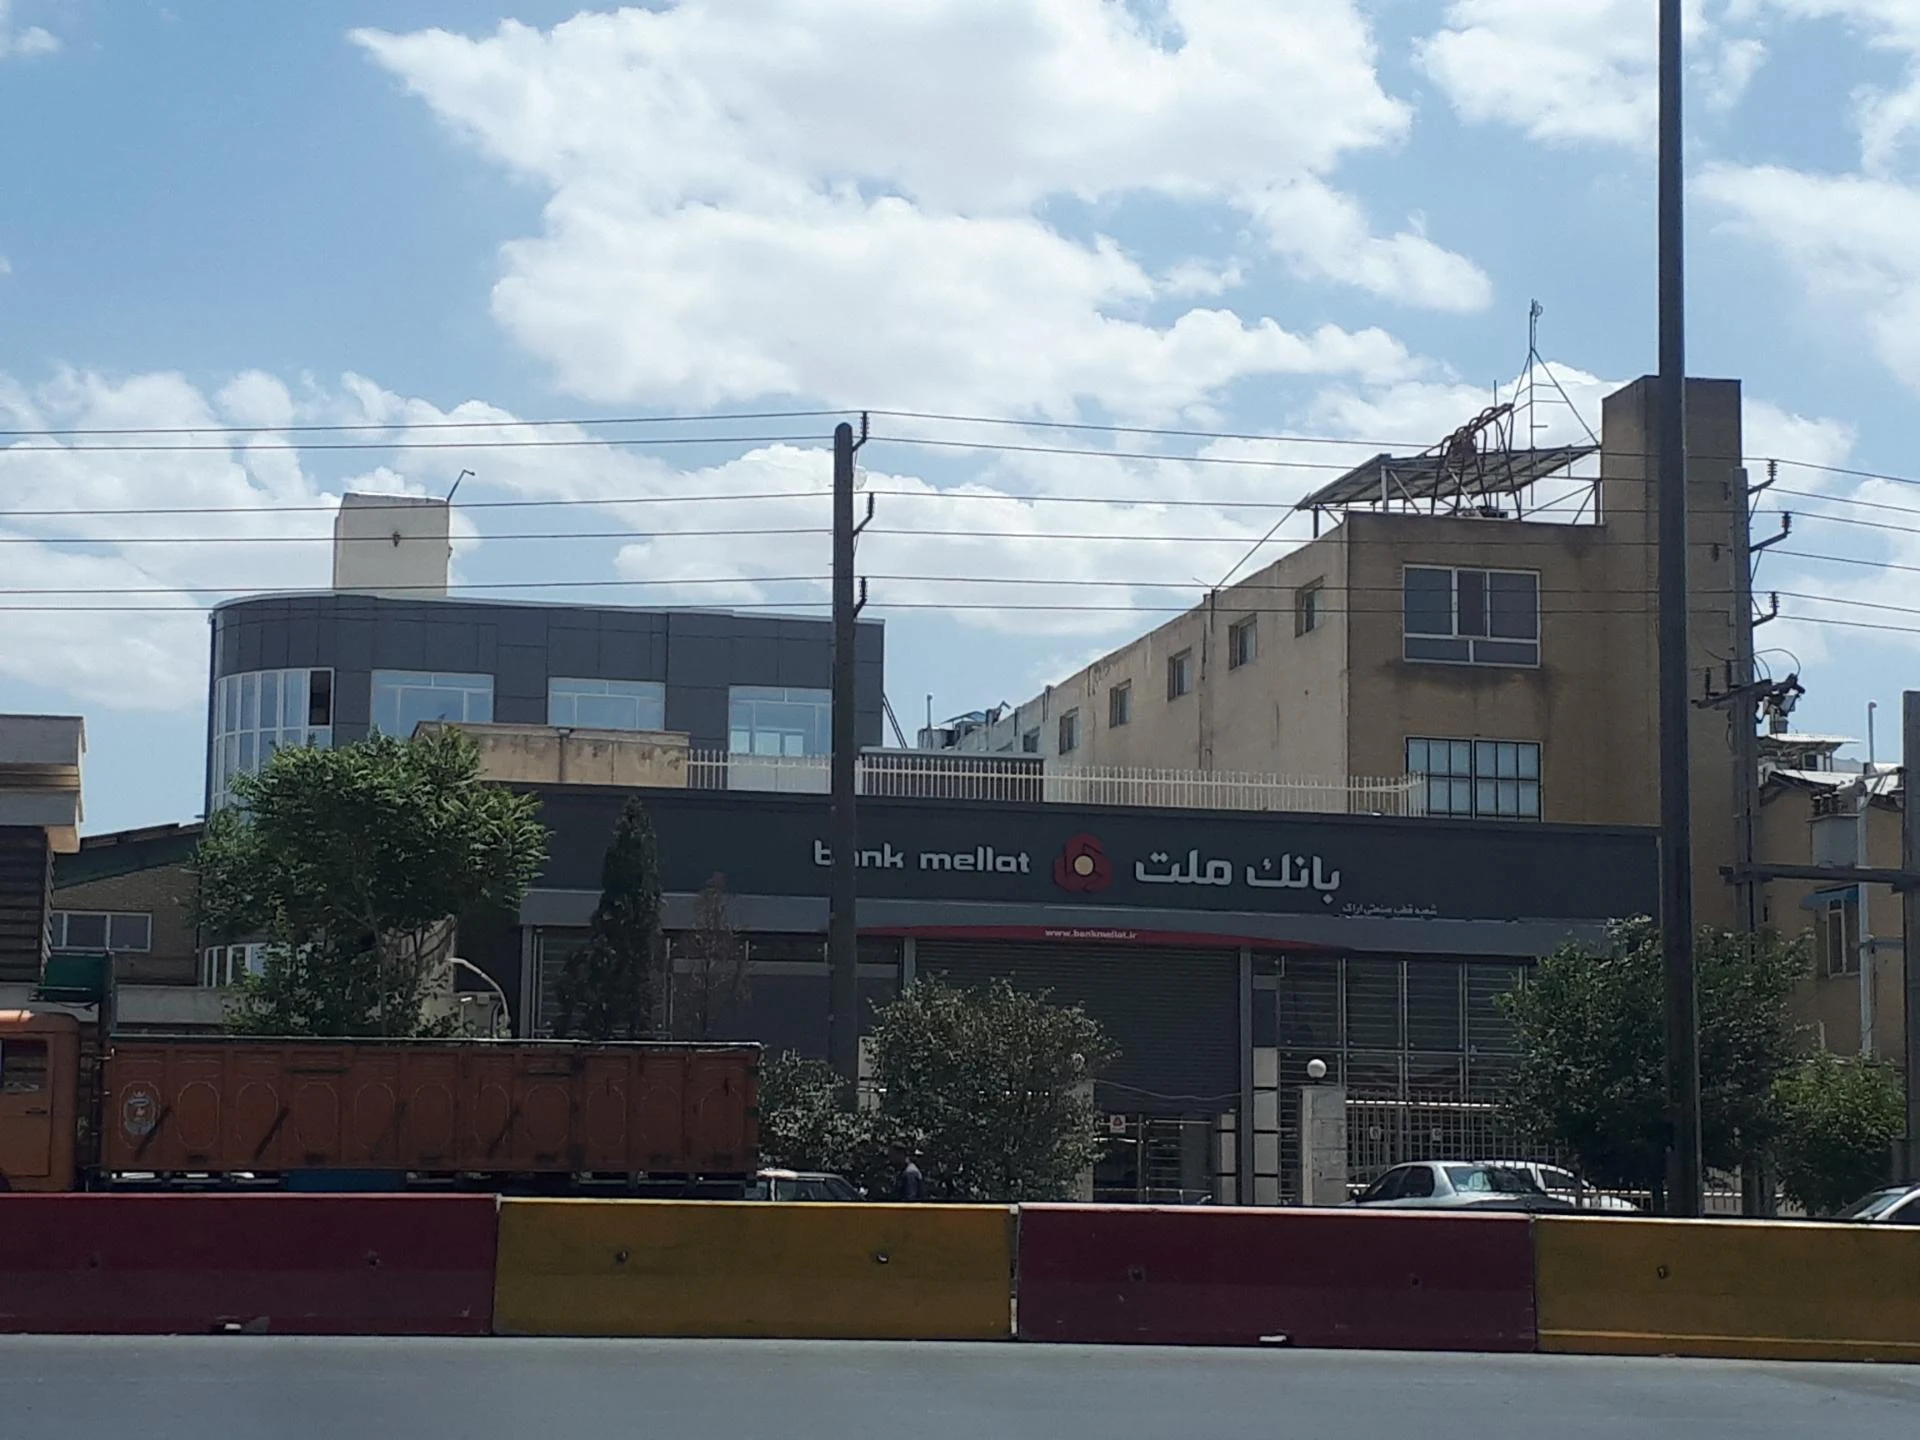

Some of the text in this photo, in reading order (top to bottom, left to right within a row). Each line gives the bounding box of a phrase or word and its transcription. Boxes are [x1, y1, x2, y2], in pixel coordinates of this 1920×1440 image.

[814, 839, 1030, 874] bnk mellat
[1135, 849, 1233, 886] ملت
[1044, 929, 1139, 940] www.bankmellat.ir
